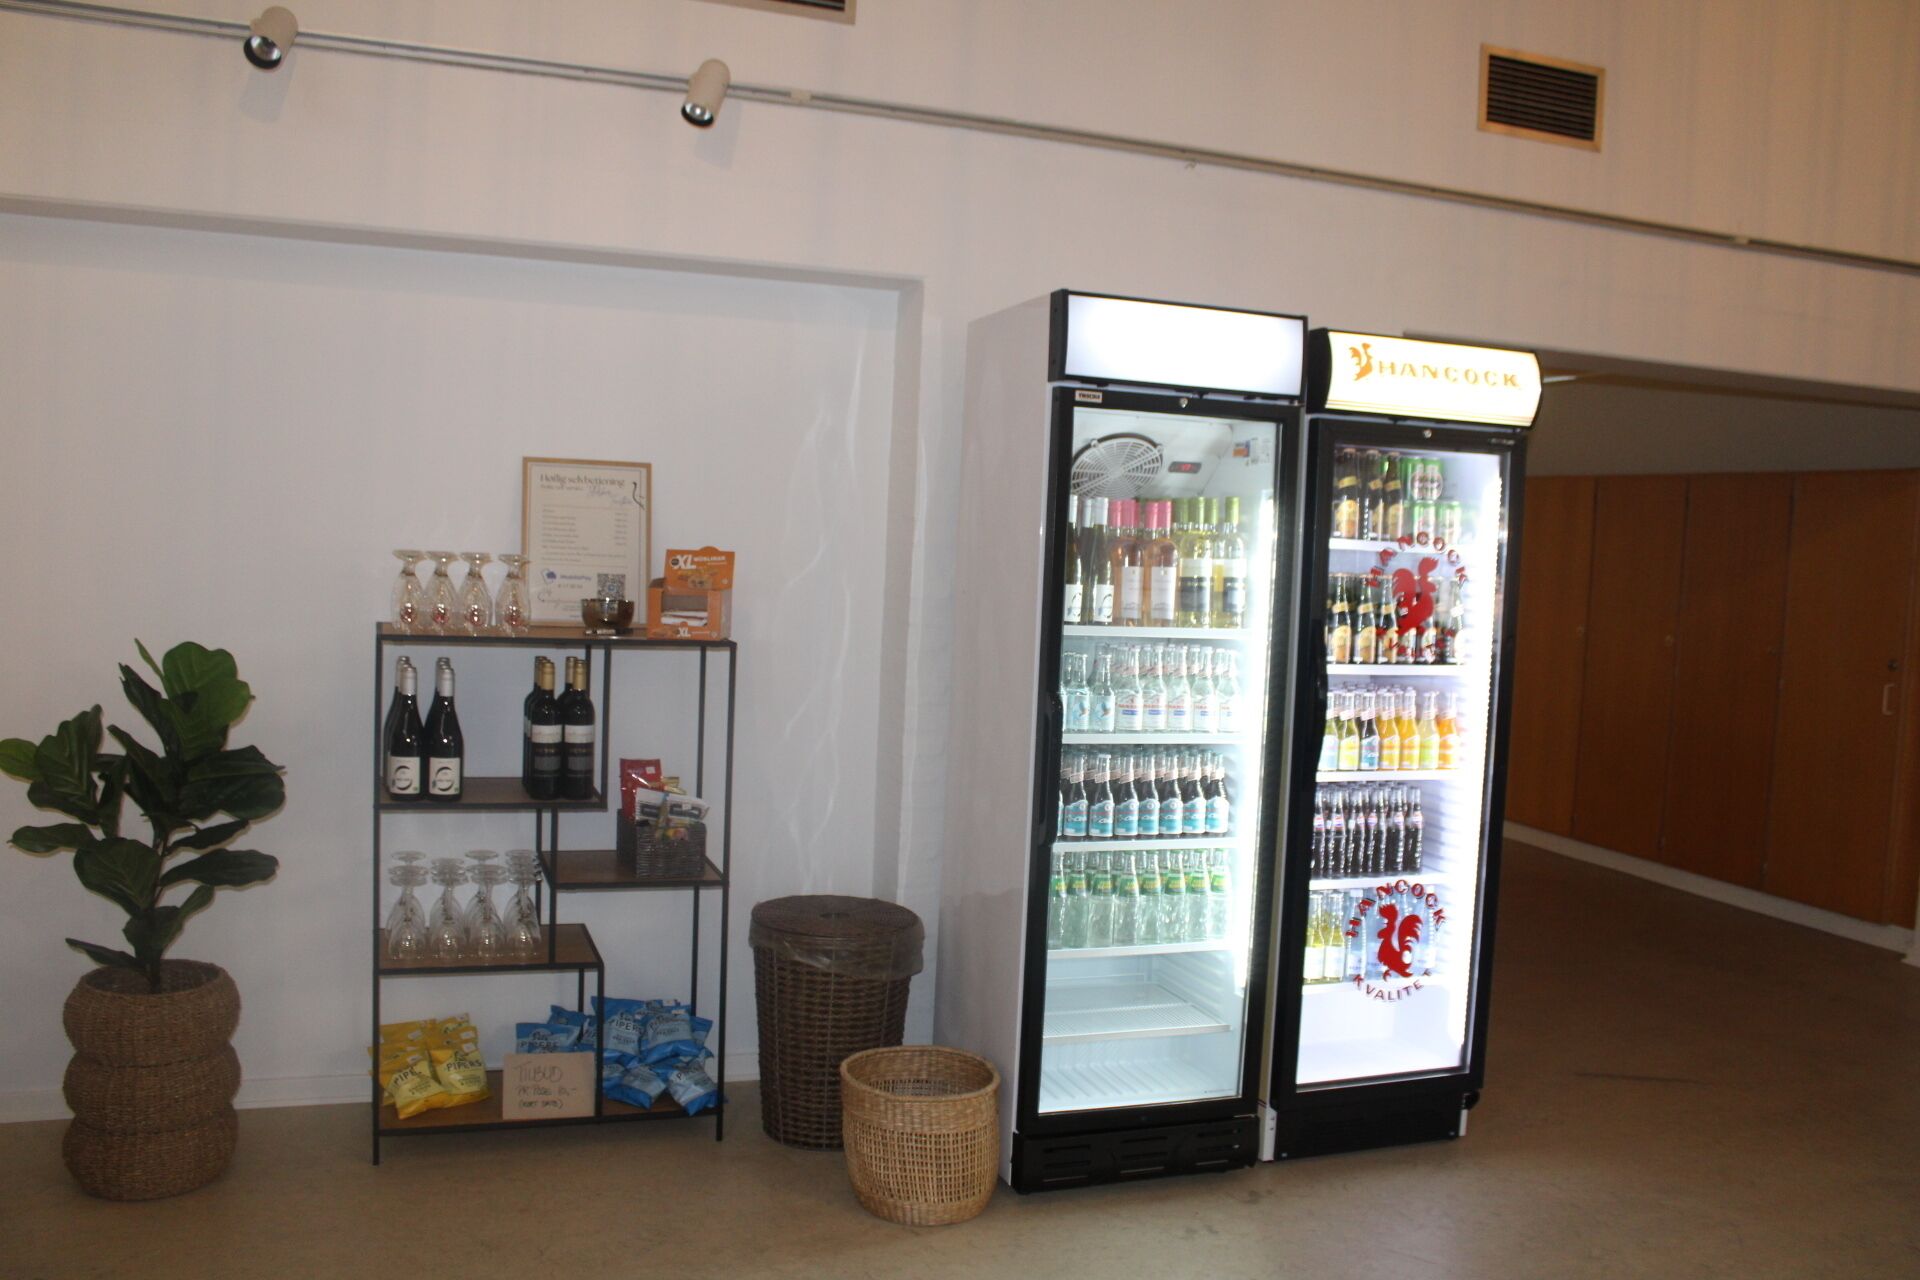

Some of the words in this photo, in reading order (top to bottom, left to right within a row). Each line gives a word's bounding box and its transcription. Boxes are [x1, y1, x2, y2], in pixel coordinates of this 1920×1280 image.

[1377, 359, 1520, 387] HANCOCK
[1345, 879, 1446, 938] HANCOCK
[446, 1059, 482, 1071] PIPERS
